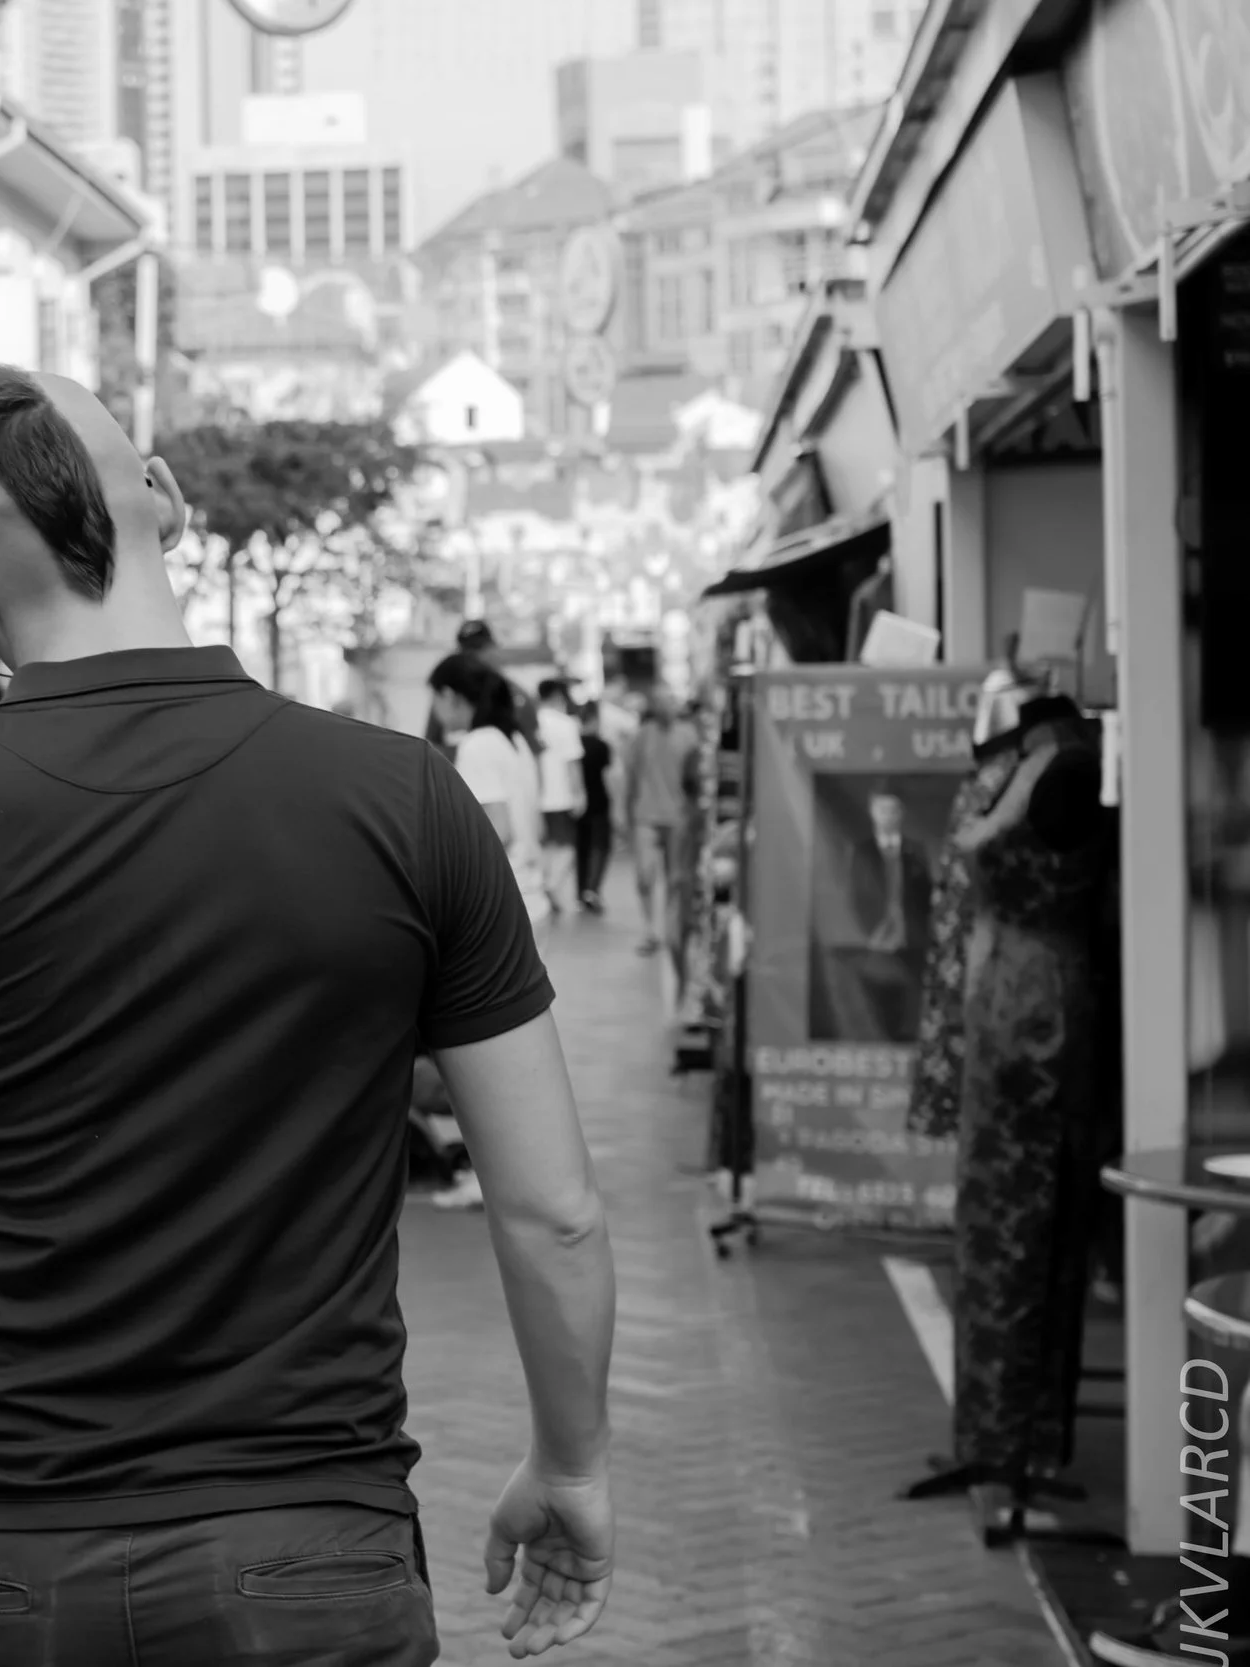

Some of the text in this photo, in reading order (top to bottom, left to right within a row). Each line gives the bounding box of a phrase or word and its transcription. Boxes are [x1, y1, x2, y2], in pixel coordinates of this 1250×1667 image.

[768, 683, 856, 721] BEST
[911, 728, 973, 759] USA
[756, 1046, 912, 1079] EUROBEST
